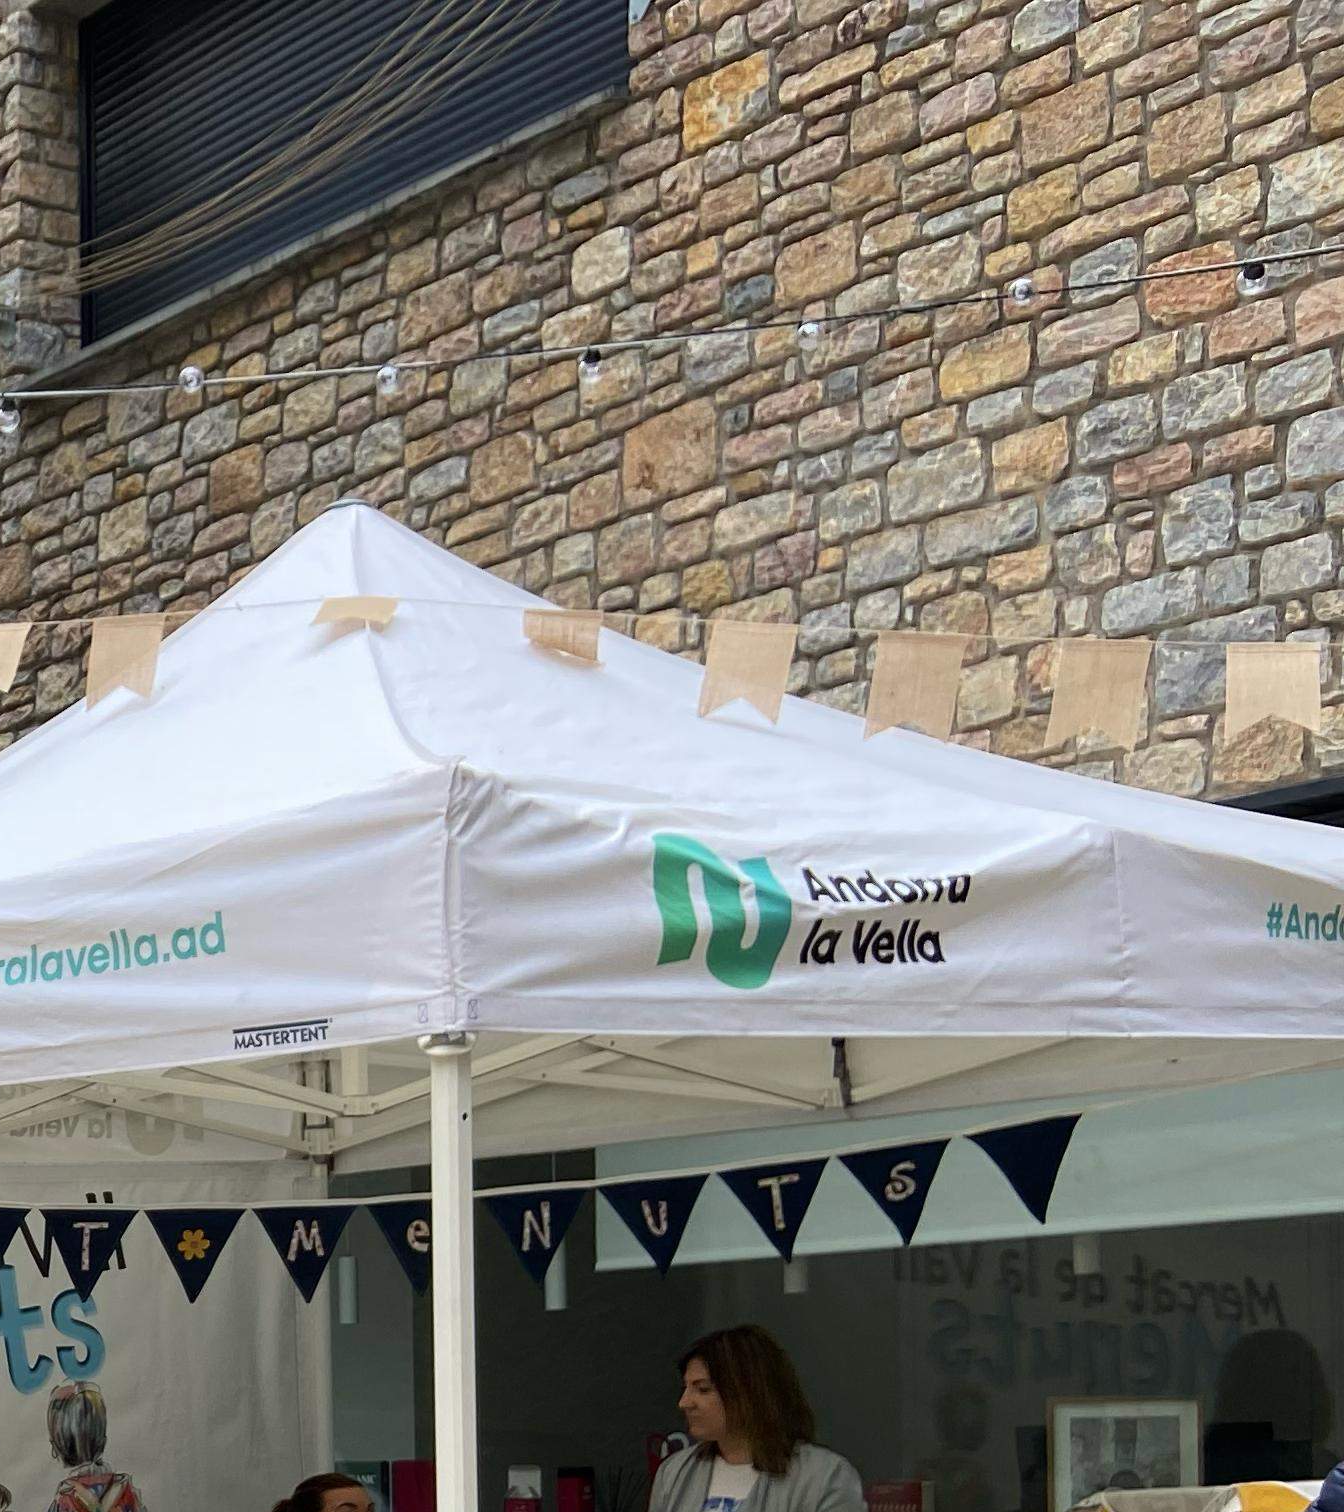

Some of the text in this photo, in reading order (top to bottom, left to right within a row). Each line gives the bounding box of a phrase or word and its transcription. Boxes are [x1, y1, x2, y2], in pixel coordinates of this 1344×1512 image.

[801, 867, 971, 903] Andorra
[800, 918, 946, 964] la Vella
[234, 1026, 328, 1049] MASTERTENT
